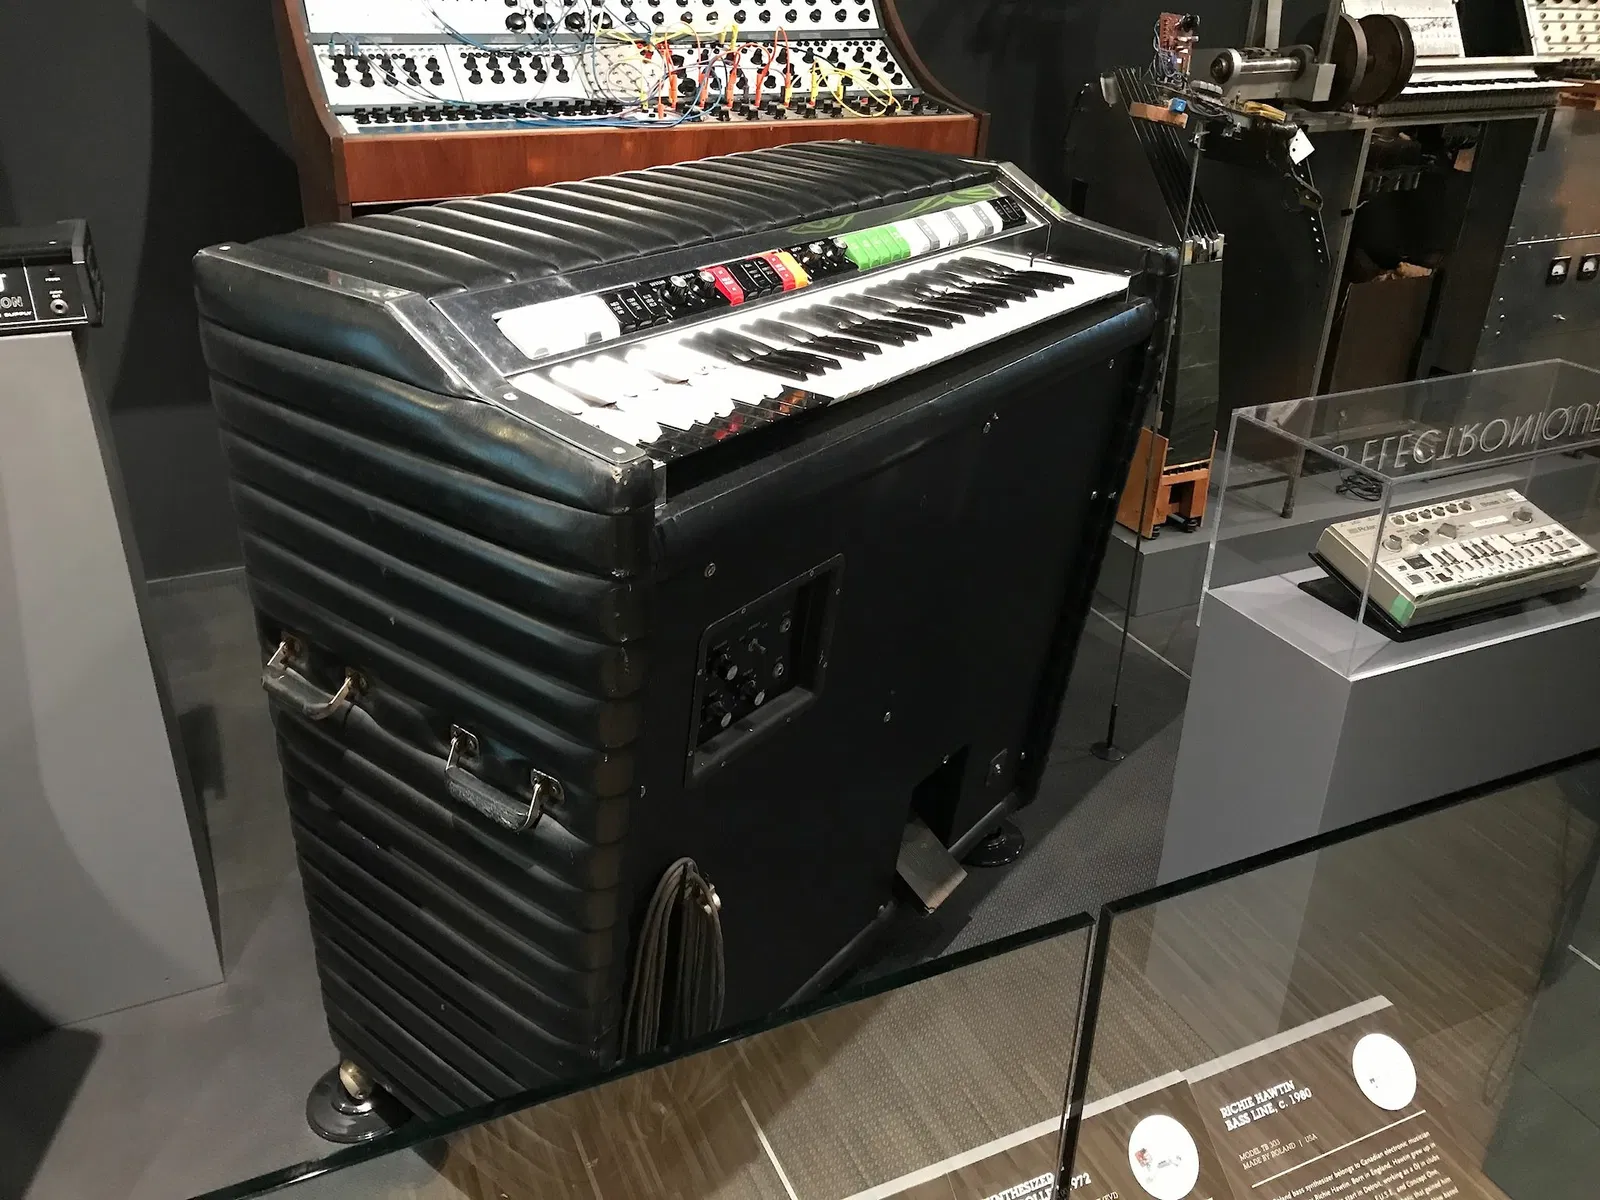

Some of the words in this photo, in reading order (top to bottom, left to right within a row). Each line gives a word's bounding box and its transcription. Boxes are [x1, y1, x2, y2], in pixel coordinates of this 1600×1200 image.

[1220, 1096, 1255, 1118] RICHIE
[1254, 1080, 1295, 1103] HAWTIN
[1225, 1112, 1251, 1131] BASS
[1251, 1102, 1278, 1120] LINE,
[1278, 1099, 1289, 1109] c.
[1288, 1087, 1313, 1105] 1980
[1239, 1147, 1261, 1161] MODEL
[1242, 1157, 1262, 1170] MADE
[1261, 1154, 1270, 1162] BY
[1270, 1142, 1296, 1158] ROLAND
[1304, 1133, 1318, 1143] USA
[1291, 1187, 1305, 1197] bass
[1305, 1174, 1334, 1192] synthesizer
[1333, 1166, 1355, 1179] belongs
[1360, 1152, 1384, 1166] Canadian
[1383, 1140, 1408, 1156] electronic
[1407, 1131, 1430, 1145] musician
[1350, 1175, 1365, 1185] Born
[1391, 1154, 1411, 1166] Hawtin
[1410, 1148, 1423, 1160] grew
[1383, 1171, 1404, 1184] working
[1426, 1154, 1440, 1165] clubs
[1069, 1173, 1092, 1191] 972
[1396, 1182, 1407, 1193] and
[1405, 1174, 1428, 1188] Concept
